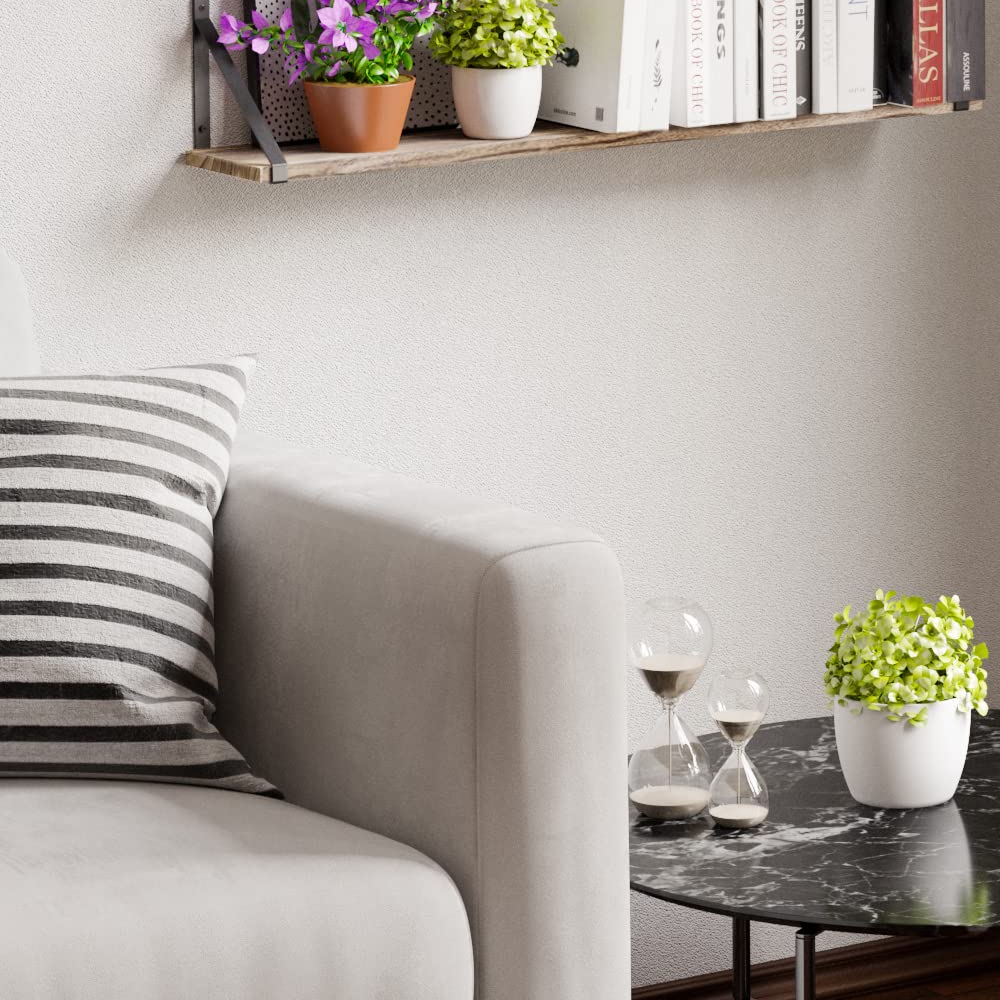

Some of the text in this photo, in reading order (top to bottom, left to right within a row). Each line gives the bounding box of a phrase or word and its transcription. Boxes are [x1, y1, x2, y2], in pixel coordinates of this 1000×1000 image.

[691, 47, 703, 69] OF
[772, 34, 788, 58] OF
[772, 63, 788, 107] CHIC
[962, 51, 971, 92] ASSOULINE
[691, 74, 704, 114] CHIC
